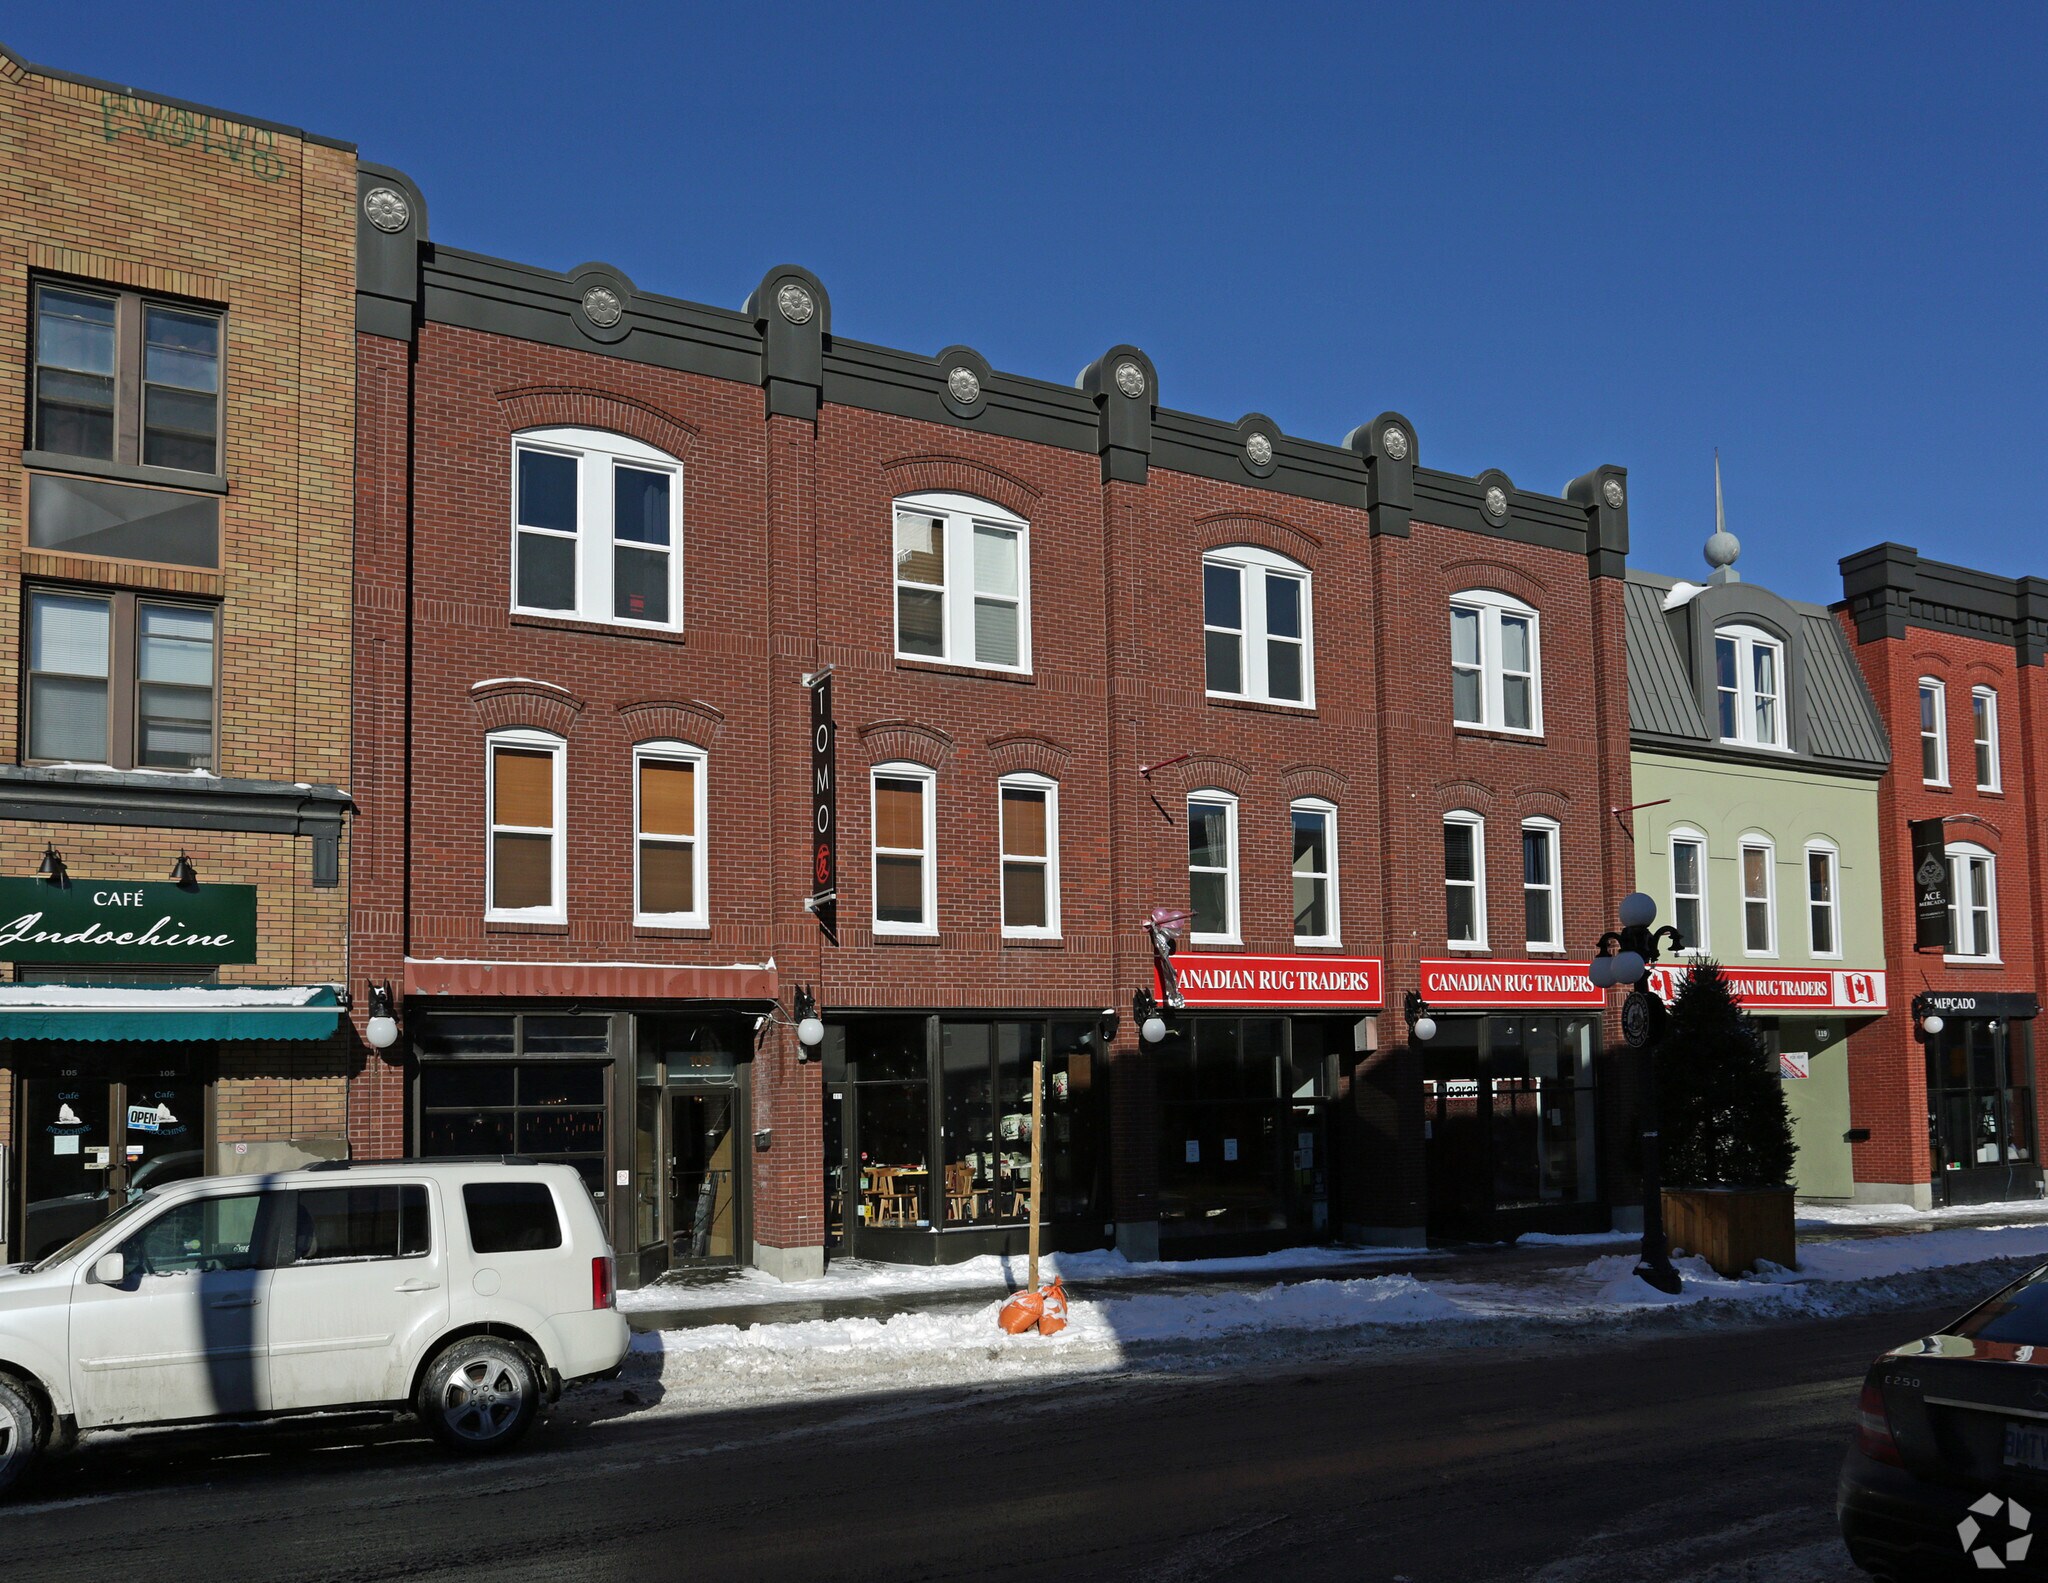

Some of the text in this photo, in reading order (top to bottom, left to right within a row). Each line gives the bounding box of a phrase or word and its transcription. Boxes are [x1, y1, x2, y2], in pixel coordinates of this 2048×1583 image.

[816, 686, 829, 834] TOMO
[93, 889, 144, 907] CAFÉ
[1923, 891, 1941, 901] ACE
[1918, 898, 1946, 908] MERCADO
[0, 911, 235, 946] Indochine
[1176, 969, 1369, 991] ANADIAN RUG TRADERS
[1428, 973, 1595, 993] CANADIAN RUG TRADERS
[1727, 979, 1828, 997] DIAN RUG TRADERS
[1934, 997, 1976, 1010] MERCADO
[1817, 1030, 1829, 1038] 119
[61, 1069, 78, 1077] 105
[57, 1091, 80, 1100] Café
[154, 1090, 176, 1099] Café
[130, 1111, 158, 1125] OPEN
[46, 1123, 93, 1136] INDOCHINE
[145, 1124, 188, 1136] DOCHINE
